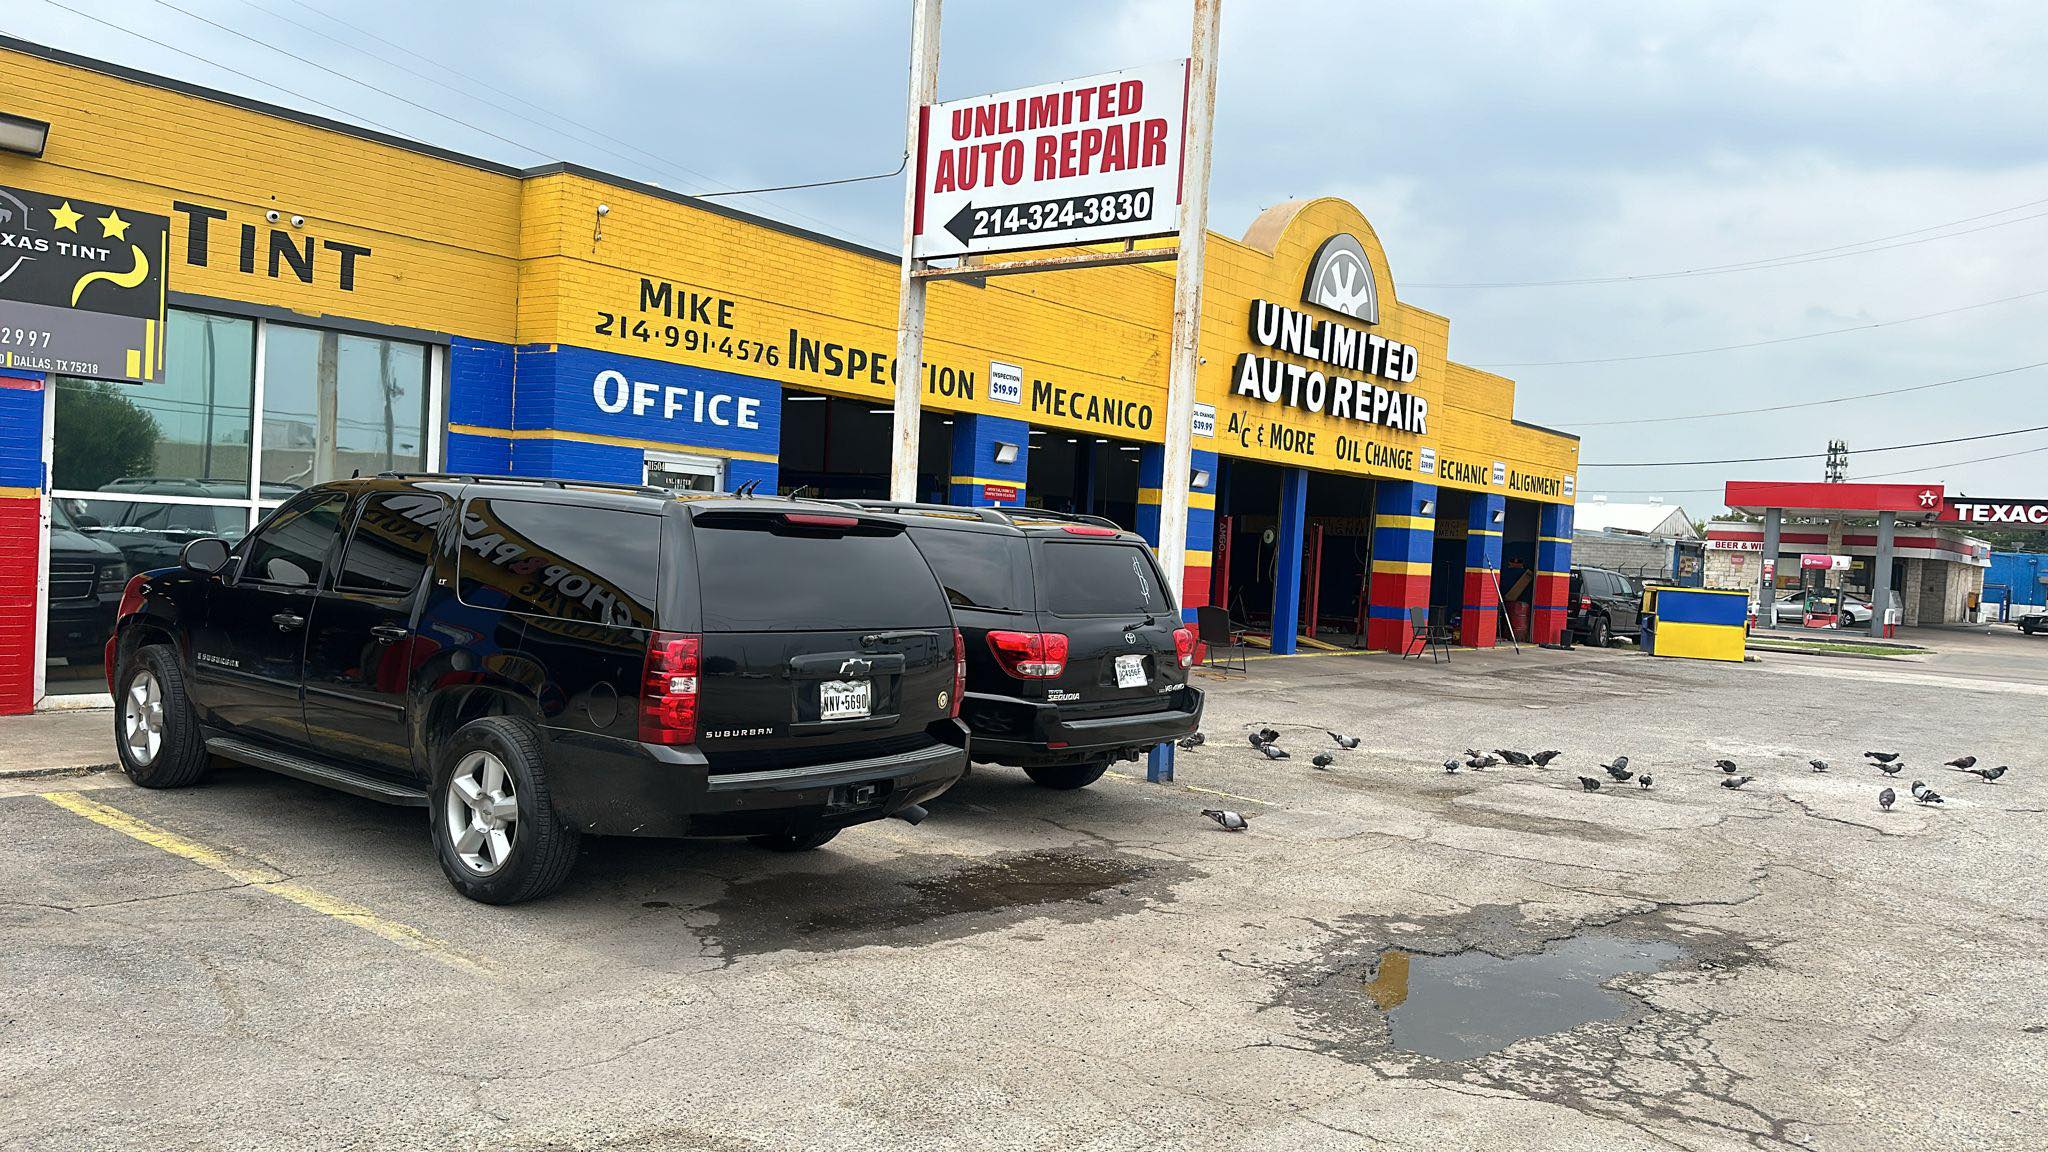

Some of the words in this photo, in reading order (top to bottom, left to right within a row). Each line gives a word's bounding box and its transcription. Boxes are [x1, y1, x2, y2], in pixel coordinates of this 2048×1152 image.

[951, 79, 1143, 142] UNLIMITED
[933, 138, 1024, 194] AUTO
[1034, 117, 1168, 182] REPAIR
[973, 191, 1150, 236] 214-324-3830
[56, 242, 111, 262] TINT
[173, 200, 372, 292] TINT
[639, 277, 736, 329] MIKE
[1256, 300, 1418, 384] UNLIMITED
[13, 354, 54, 370] DALLAS,
[56, 360, 68, 371] TX
[70, 360, 98, 374] 75218
[788, 329, 975, 400] INSPEION
[993, 371, 1020, 382] INSPECTION
[593, 369, 760, 430] OFFICE
[993, 382, 1018, 396] $19.99
[1032, 379, 1153, 430] MECANICO
[1237, 352, 1326, 412] AUTO
[1332, 376, 1428, 434] REPAIR
[1193, 419, 1213, 431] $39.99
[1270, 423, 1316, 455] MORE
[1336, 435, 1361, 463] OIL
[1365, 441, 1413, 471] CHANGE
[1438, 455, 1488, 486] ECHANIC
[1509, 470, 1560, 497] ALIGNMENT
[1715, 541, 1738, 549] BEER
[1046, 693, 1080, 702] SEQUOIA
[706, 728, 773, 739] SUBURBAN
